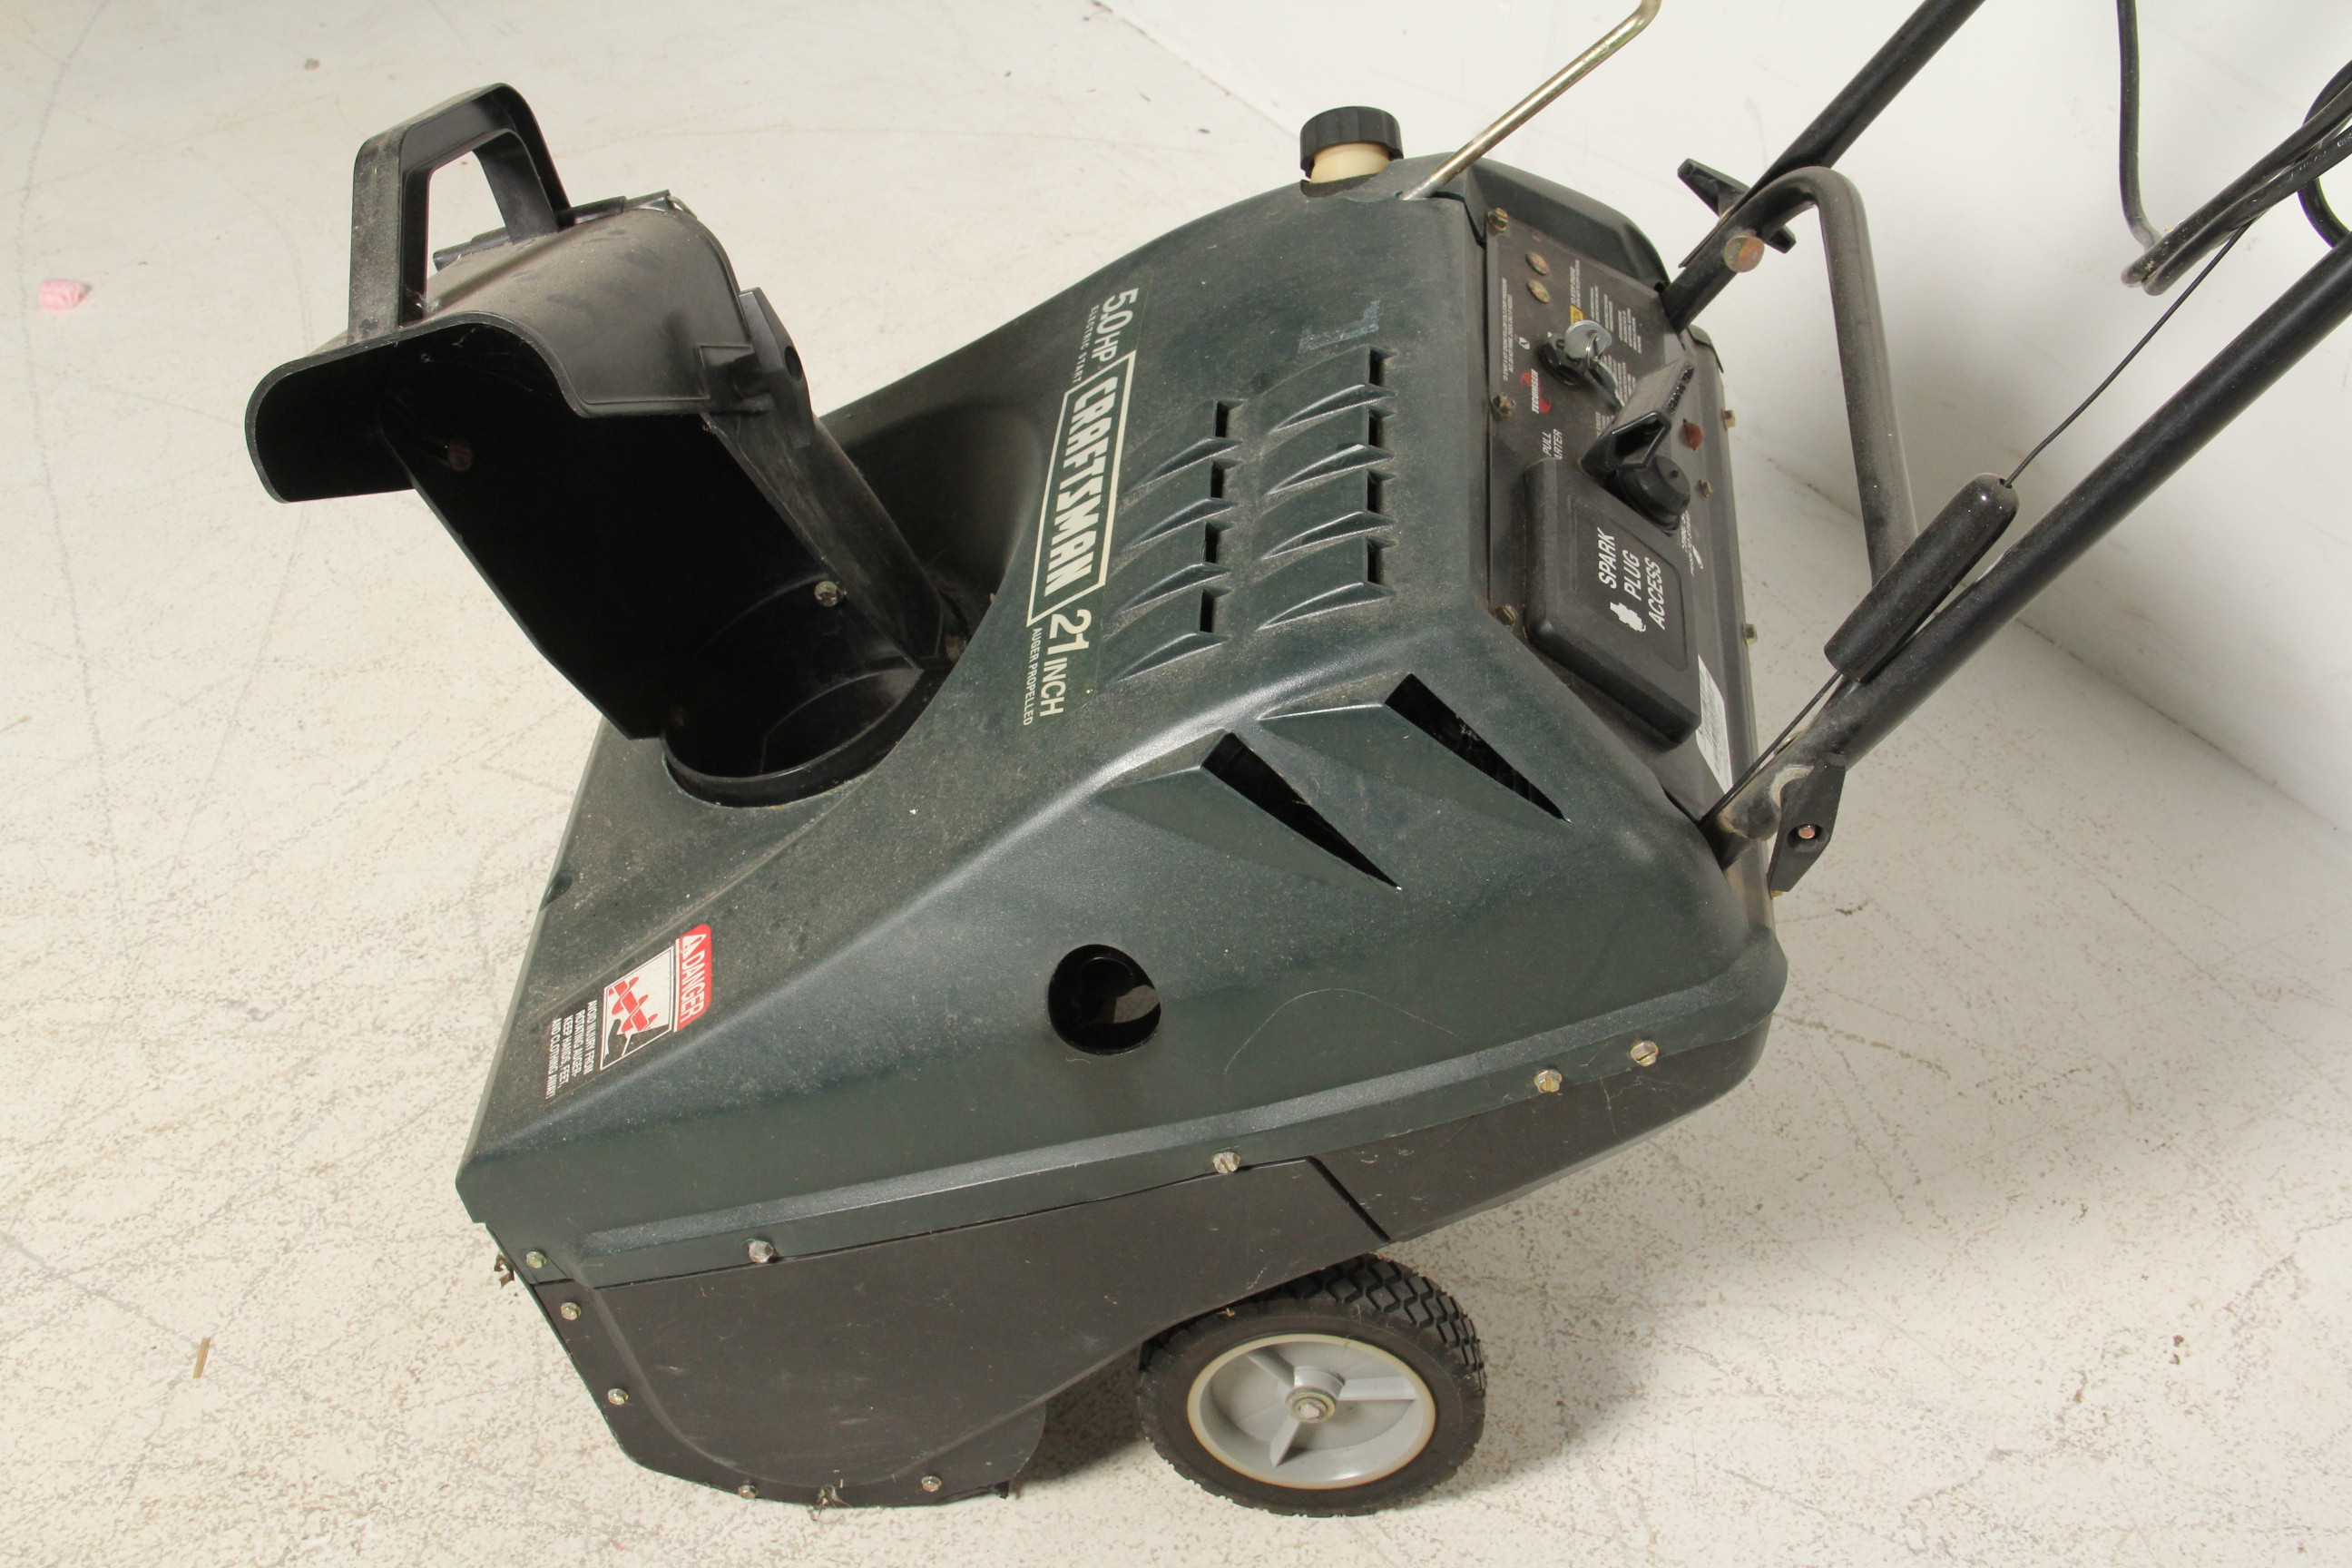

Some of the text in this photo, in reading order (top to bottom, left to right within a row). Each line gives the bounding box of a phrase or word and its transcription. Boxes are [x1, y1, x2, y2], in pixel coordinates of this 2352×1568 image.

[1073, 304, 1099, 383] ELECTRIC START
[1531, 368, 1539, 414] TECUMSEH
[1542, 431, 1552, 456] PULL
[1553, 428, 1563, 460] ARTER
[1044, 377, 1119, 597] CRAFTSMAN
[1597, 526, 1617, 589] SPARK
[1622, 549, 1642, 601] PLUG
[1644, 556, 1665, 630] ACCESS
[1023, 627, 1043, 726] AUGER PROPELLED
[1039, 609, 1092, 717] 21 INCH
[680, 949, 706, 1023] DANGER
[545, 1017, 562, 1100] AND CLOTHING AWAY!
[563, 1014, 573, 1036] KEEP
[573, 1009, 585, 1049] ROTATING
[583, 999, 597, 1075] AVOID INJURY FROM
